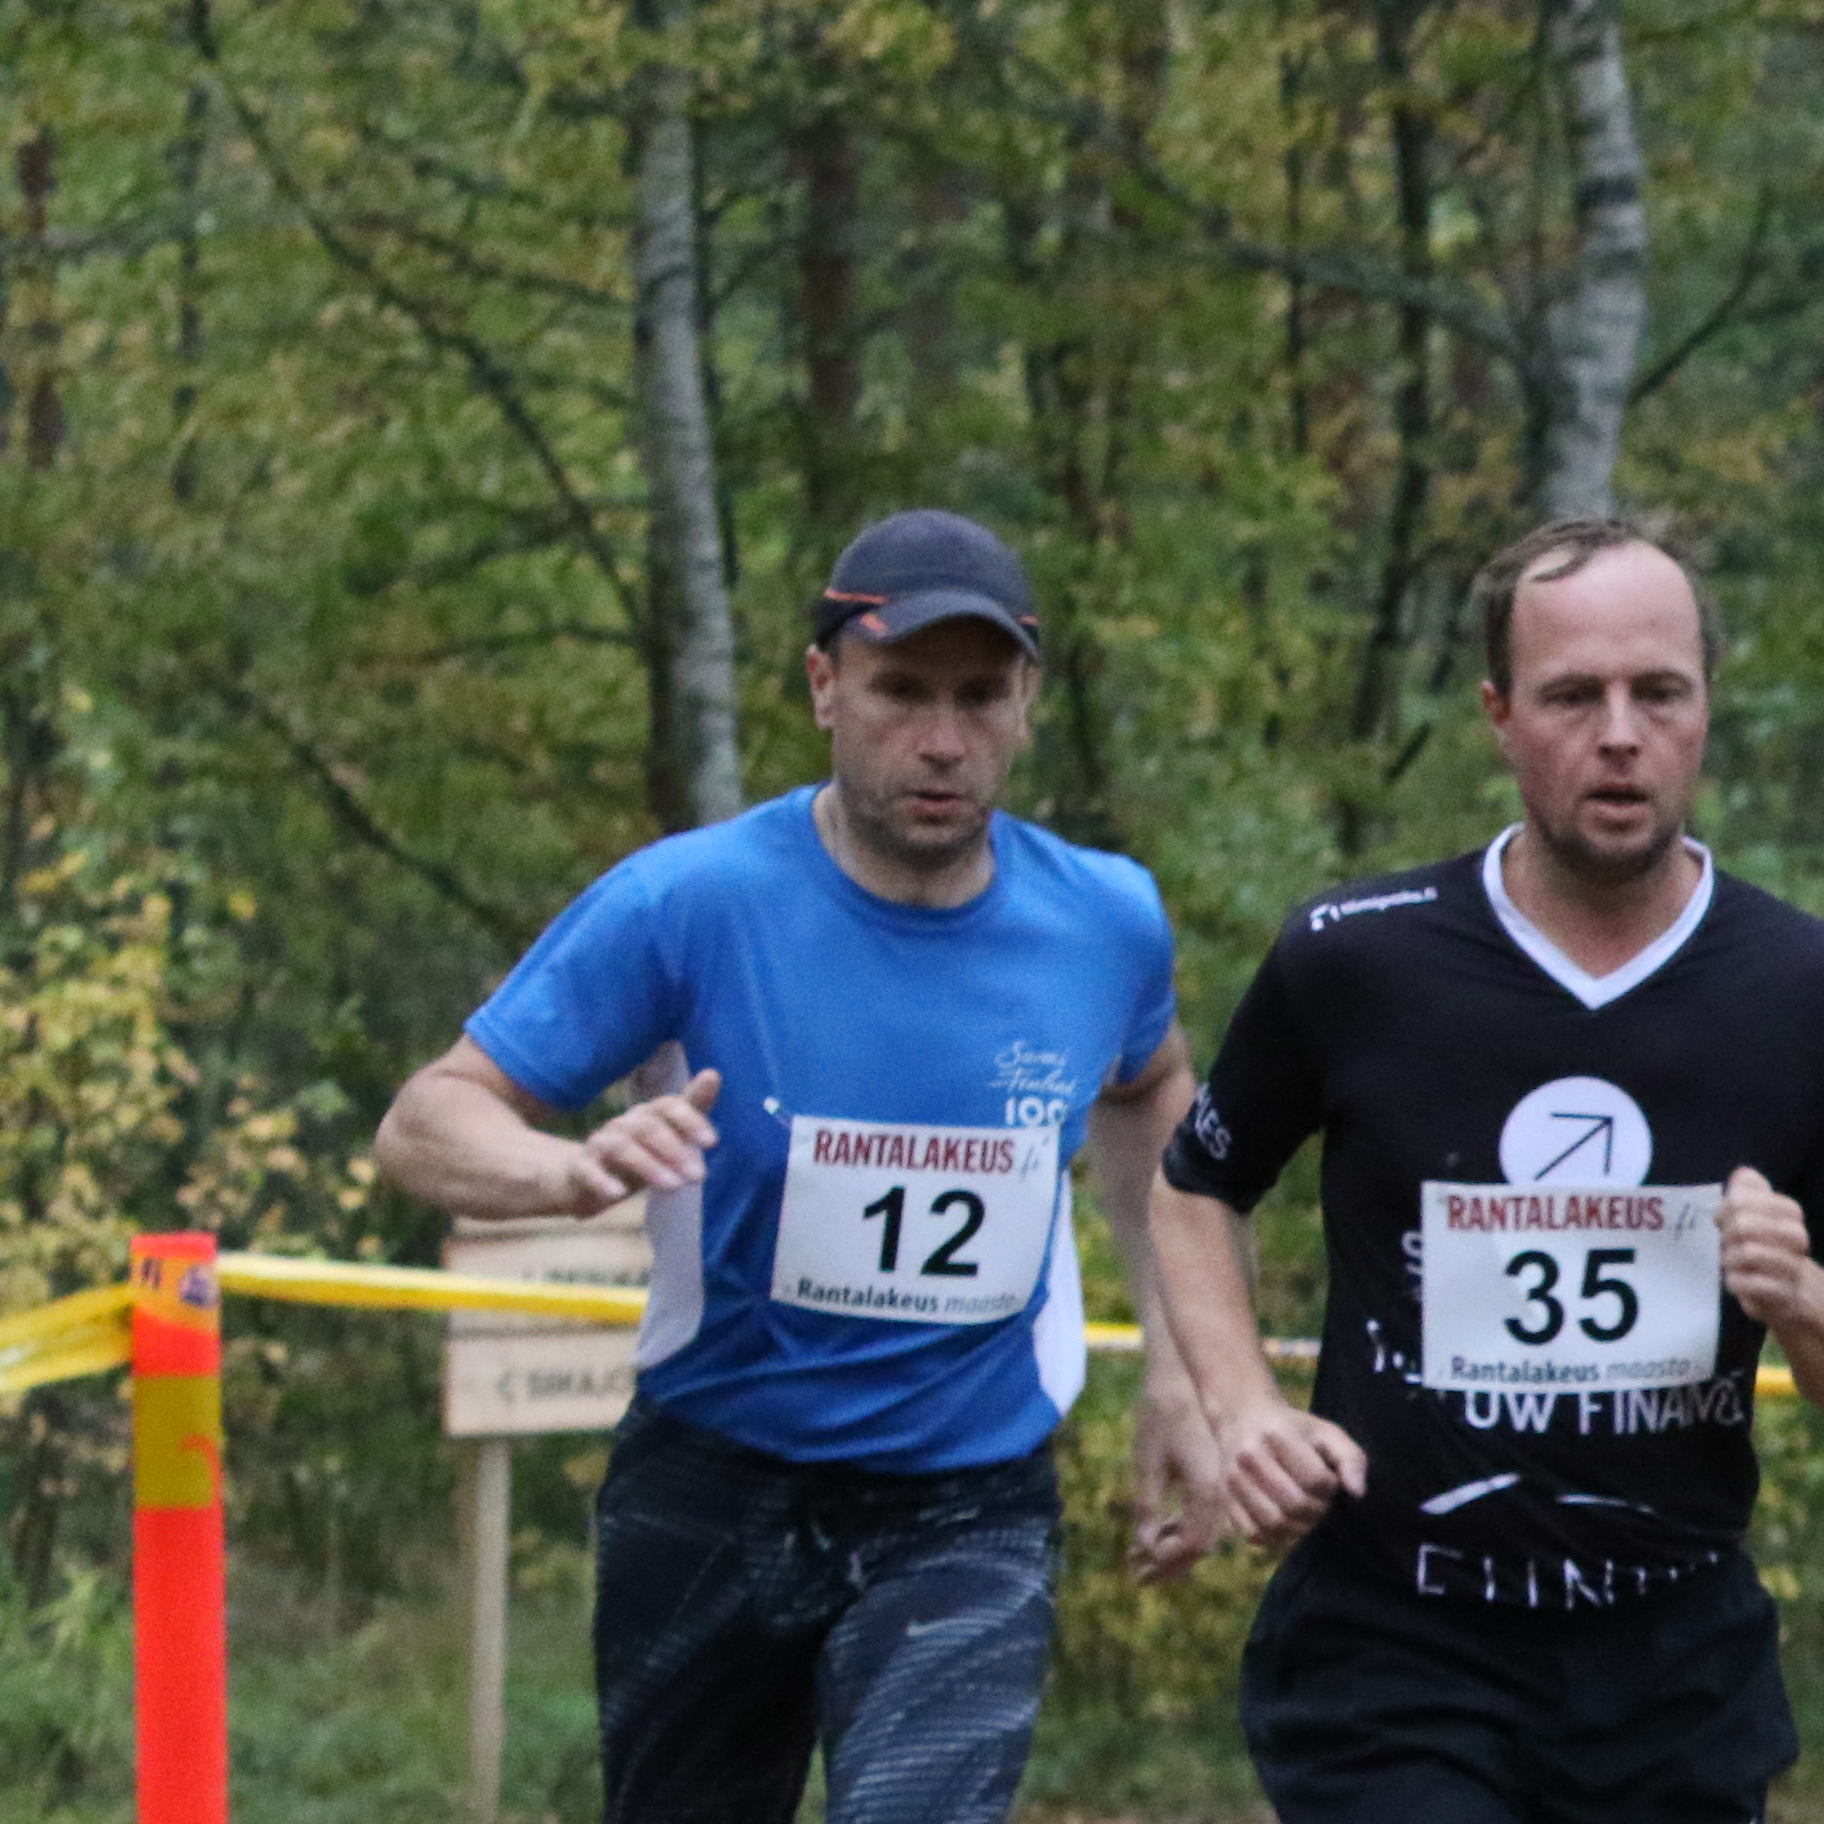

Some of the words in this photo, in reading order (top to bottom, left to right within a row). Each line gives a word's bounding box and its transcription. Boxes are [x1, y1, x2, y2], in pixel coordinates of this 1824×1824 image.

[813, 1129, 1014, 1173] RANTALAKEUS
[862, 1185, 987, 1277] 12
[1446, 1196, 1665, 1232] RANTALAKEUS
[798, 1277, 938, 1312] Rantalakeus
[1504, 1248, 1639, 1346] 35
[1450, 1356, 1600, 1382] Rantalakeus
